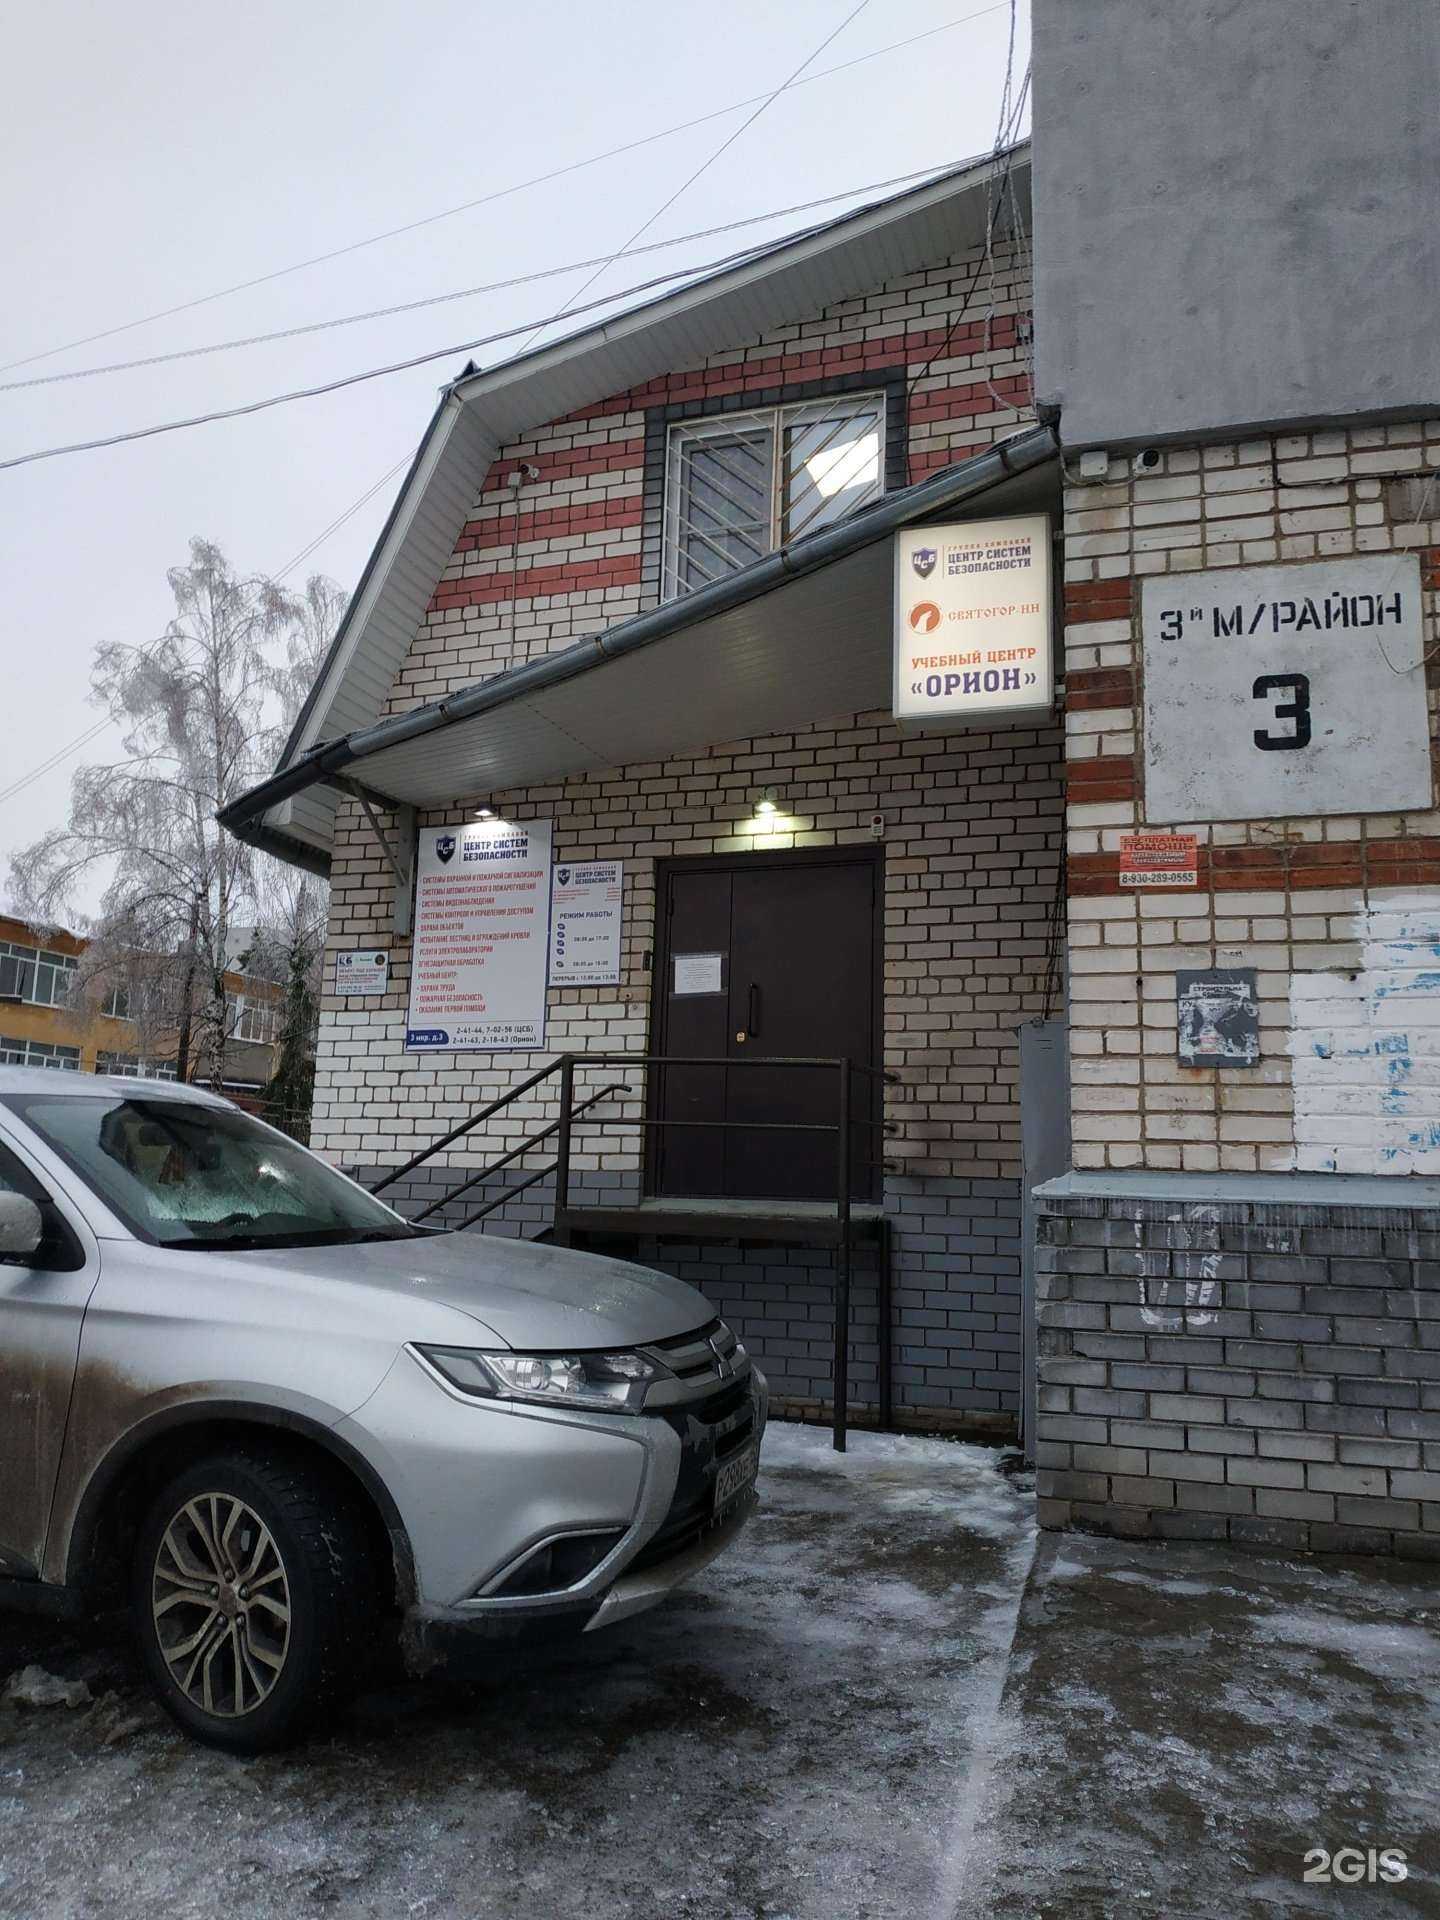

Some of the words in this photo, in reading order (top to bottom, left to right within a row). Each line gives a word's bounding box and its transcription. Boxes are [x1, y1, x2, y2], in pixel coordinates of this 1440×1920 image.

[948, 551, 984, 564] ЦЕНТР
[986, 546, 1031, 560] СИСТЕМ
[948, 558, 1031, 576] БЕЗОПАСНОСТИ
[1213, 591, 1403, 638] М/РАЙОН
[911, 650, 982, 670] УЧЕБНЫЙ
[987, 647, 1037, 666] ЦЕНТР
[911, 668, 1037, 698] «ОРИОН»
[1252, 672, 1312, 752] 3
[464, 841, 491, 852] ЦЕНТР
[493, 838, 528, 850] СИСТЕМ
[464, 849, 528, 861] БЕЗОПАСНОСТИ
[423, 876, 446, 885] СИСТЕМЫ
[422, 887, 445, 896] СИСТЕМЫ
[422, 899, 445, 908] СИСТЕМЫ
[420, 910, 444, 919] СИСТЕМЫ
[559, 912, 584, 920] РЕЖИМ
[585, 911, 613, 919] РАБОТЫ
